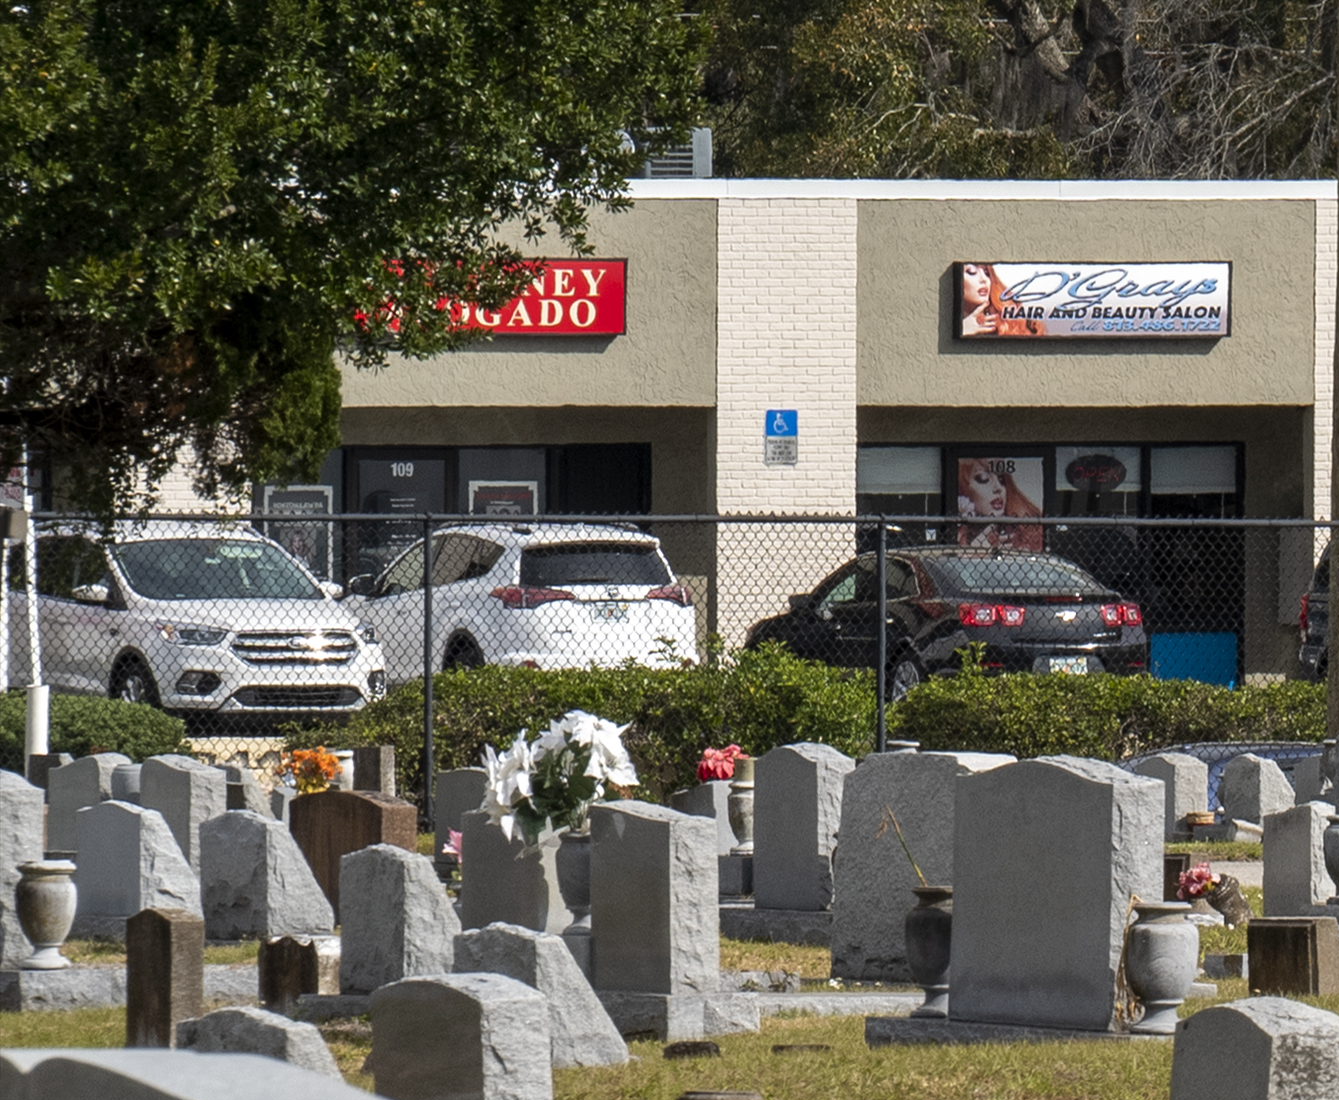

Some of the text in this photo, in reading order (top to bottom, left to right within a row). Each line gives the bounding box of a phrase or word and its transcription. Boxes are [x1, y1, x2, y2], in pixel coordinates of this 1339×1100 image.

[1000, 268, 1219, 311] D'Grays
[1002, 306, 1221, 319] HAIR AND BEAUTY SALON
[1070, 320, 1221, 332] Call 813.486.1722
[390, 462, 414, 477] 109
[988, 460, 1016, 474] 108
[1072, 466, 1122, 483] OPEN
